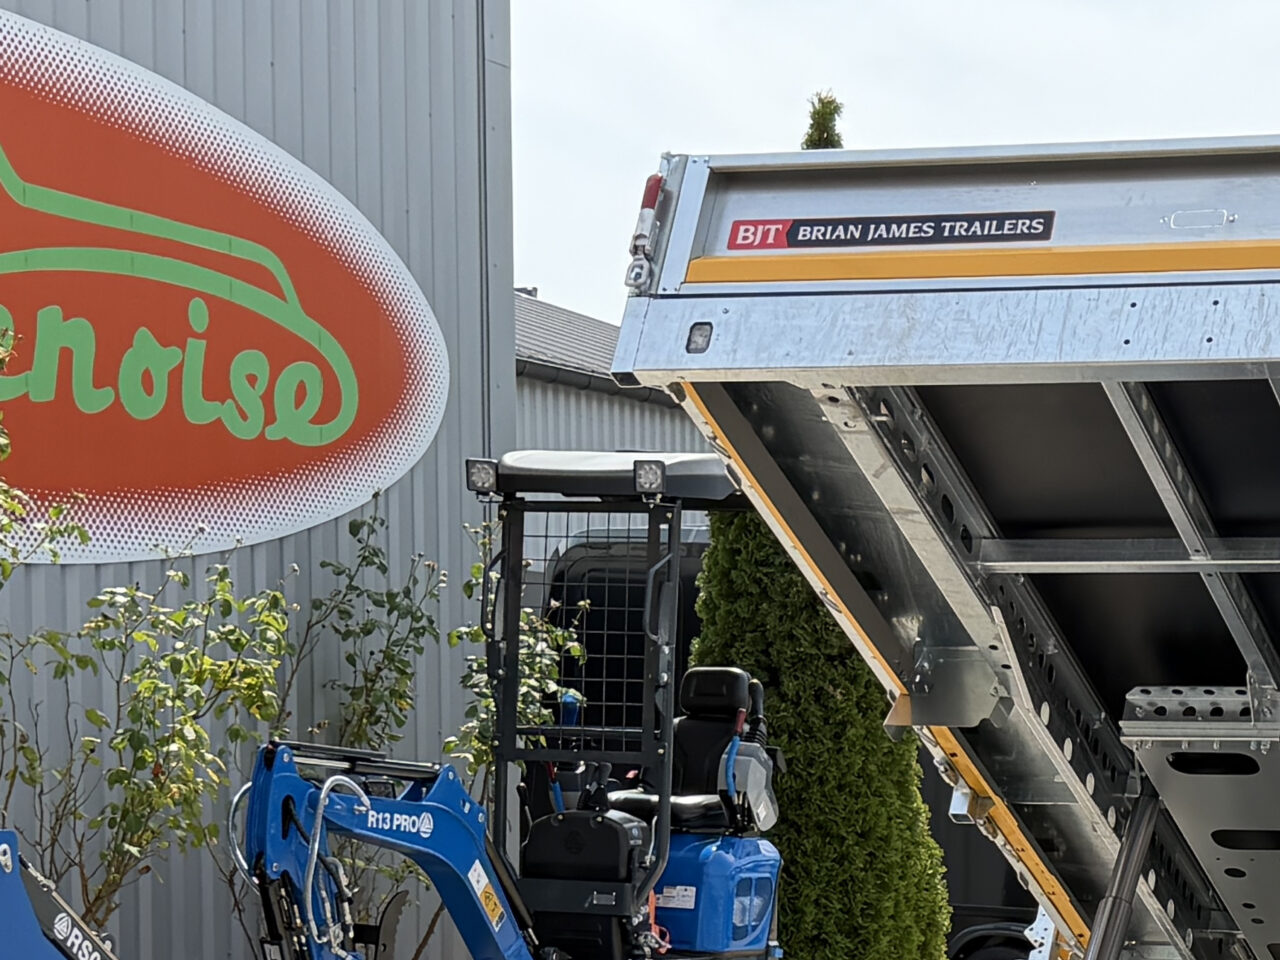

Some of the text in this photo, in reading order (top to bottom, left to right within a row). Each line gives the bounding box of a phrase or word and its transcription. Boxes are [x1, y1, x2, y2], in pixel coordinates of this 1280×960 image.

[797, 224, 863, 241] BRIAN
[867, 222, 935, 241] JAMES
[941, 218, 1045, 237] TRAILERS
[367, 810, 419, 833] R13 PRO
